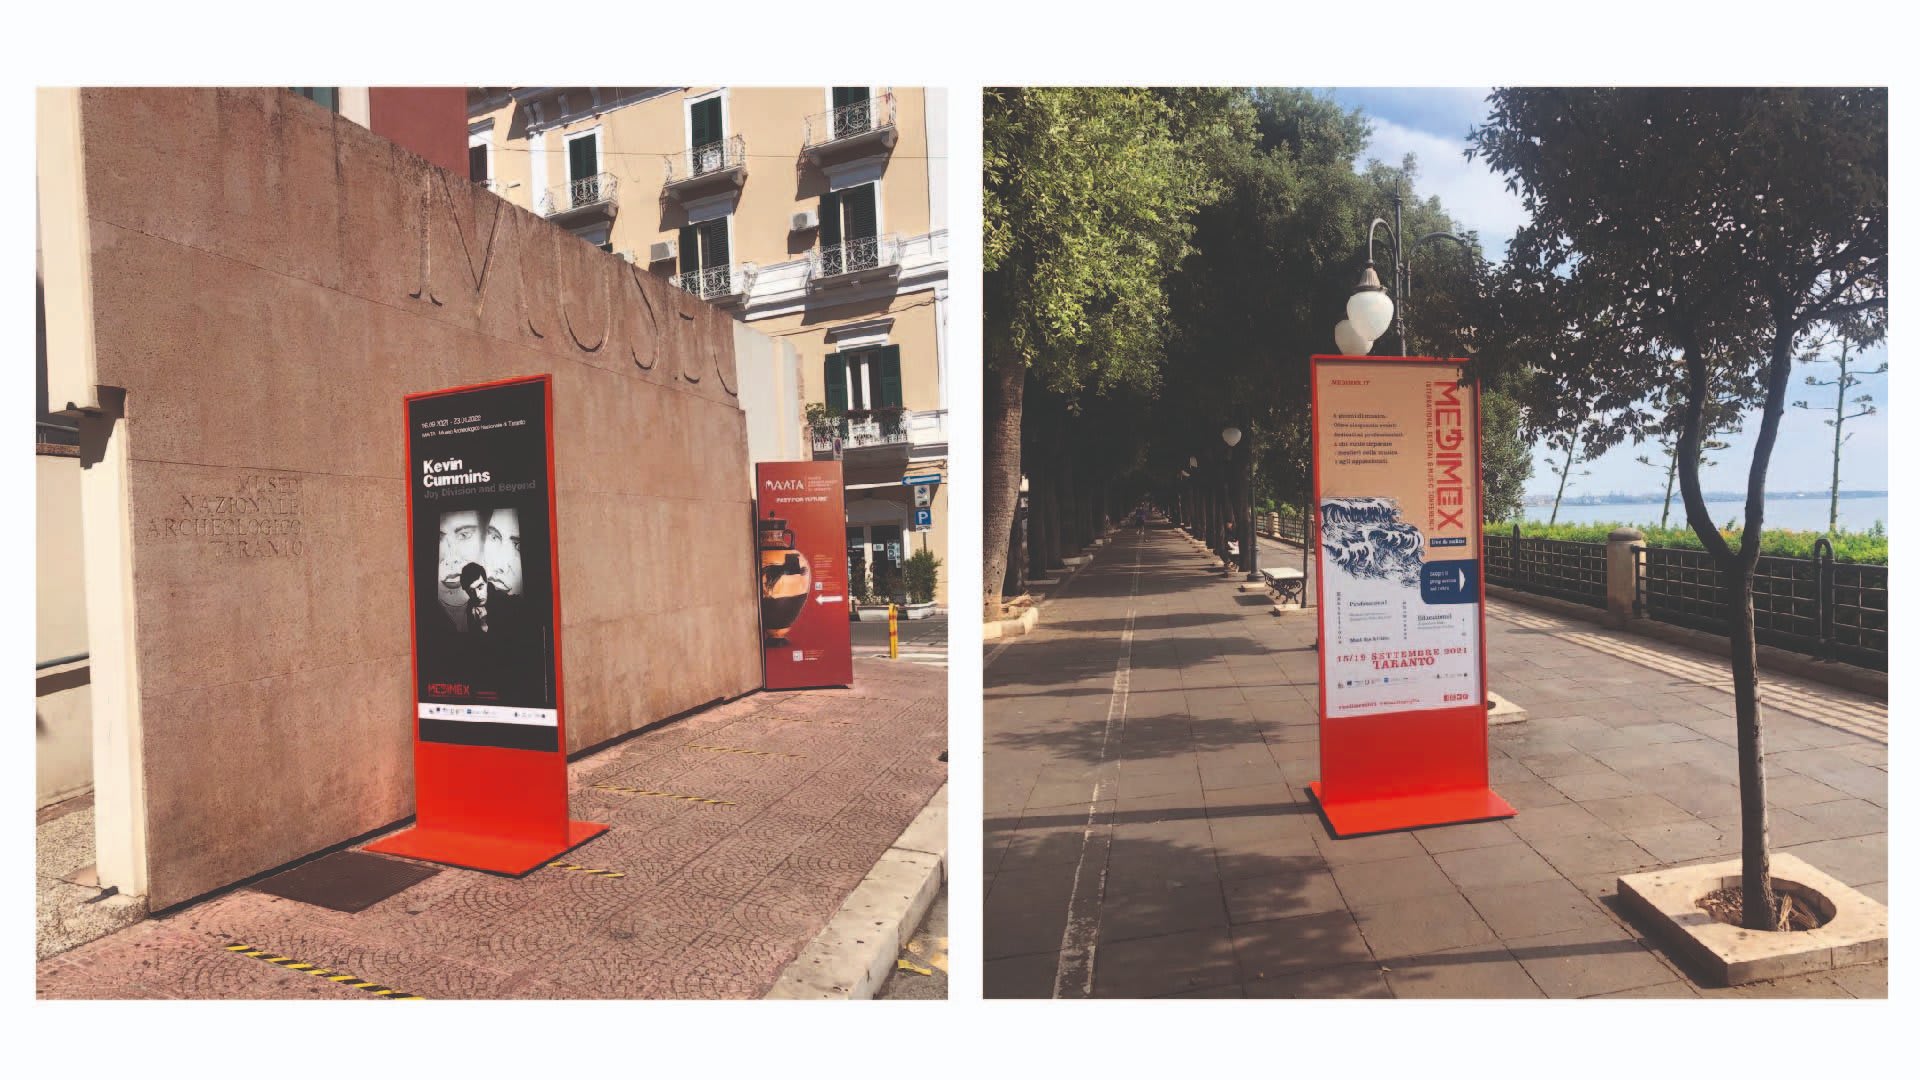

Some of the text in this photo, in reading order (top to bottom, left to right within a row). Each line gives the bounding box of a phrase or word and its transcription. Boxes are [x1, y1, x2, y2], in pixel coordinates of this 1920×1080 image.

[1434, 381, 1464, 530] MEDIMEX
[423, 458, 463, 474] Kevin
[423, 469, 490, 487] Cummins
[424, 480, 536, 499] Joy Division and Beyond
[182, 495, 300, 515] NAZIONALE
[918, 511, 928, 524] P
[146, 518, 302, 538] ARCHEOLOGICO
[209, 540, 304, 558] TARANTO
[1336, 654, 1366, 663] 15/19
[1371, 648, 1440, 660] SETTEMBRE
[1372, 656, 1435, 670] TARANTO
